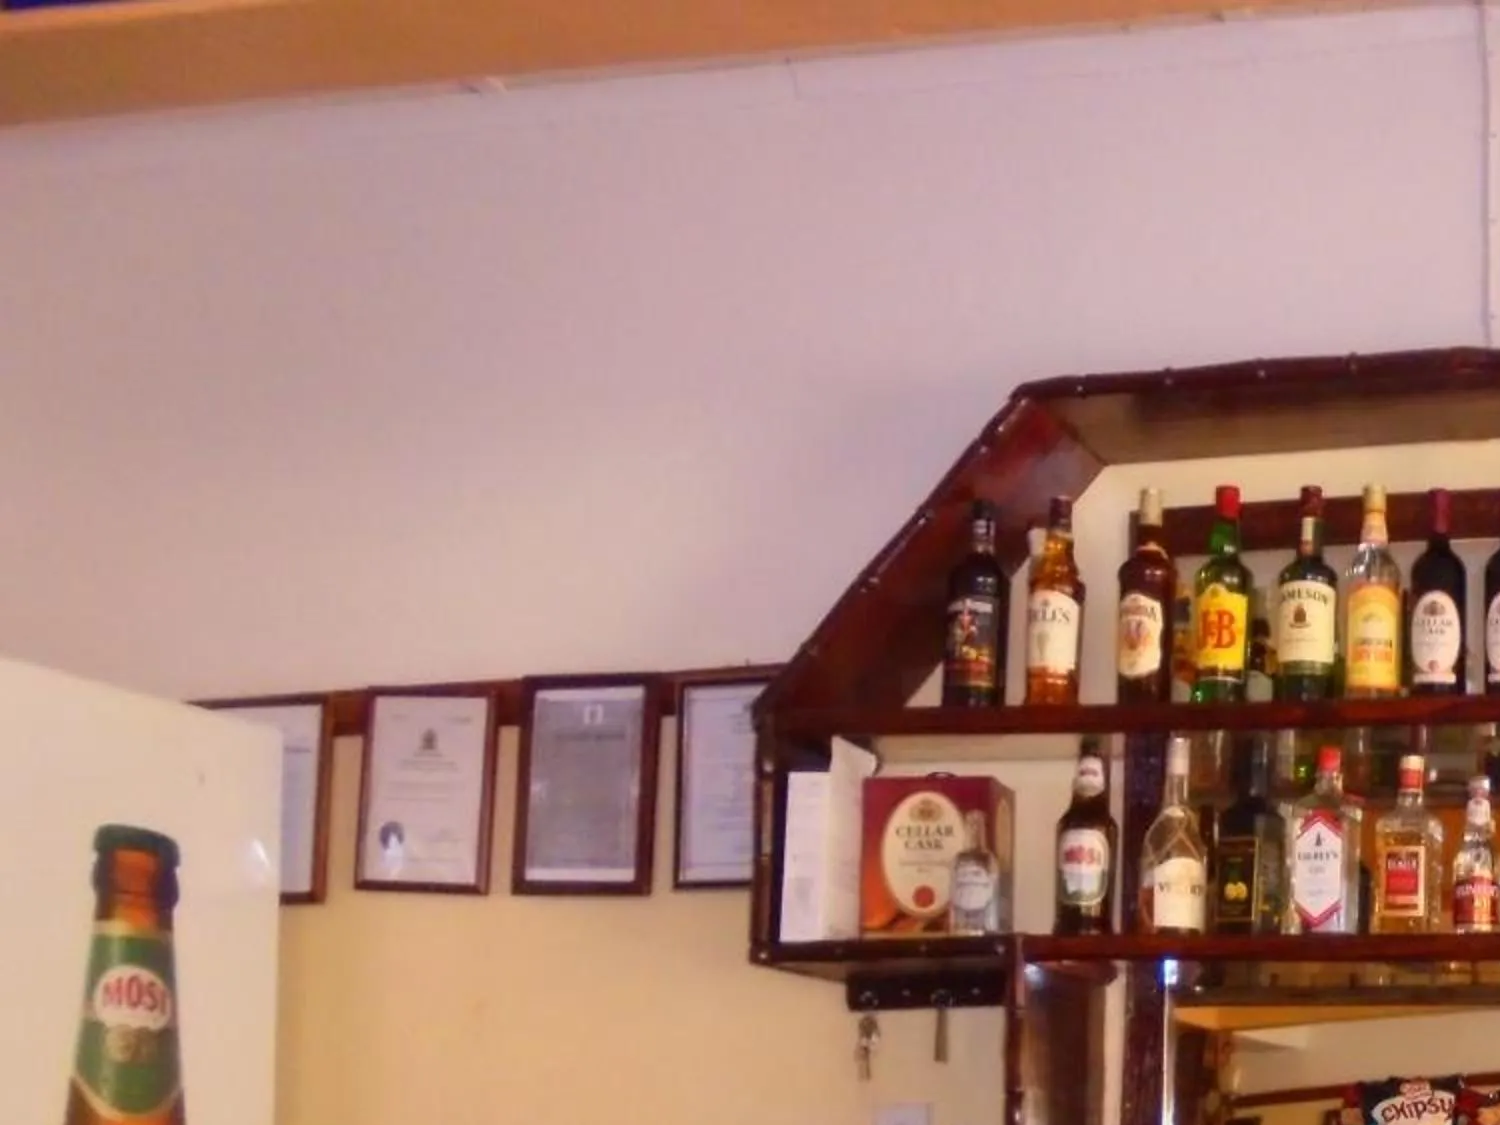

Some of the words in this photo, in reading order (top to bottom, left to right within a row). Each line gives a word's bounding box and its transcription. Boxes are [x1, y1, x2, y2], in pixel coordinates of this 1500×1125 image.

[894, 824, 956, 838] CELLAR
[903, 839, 945, 850] CASK
[101, 973, 168, 1017] MOSI
